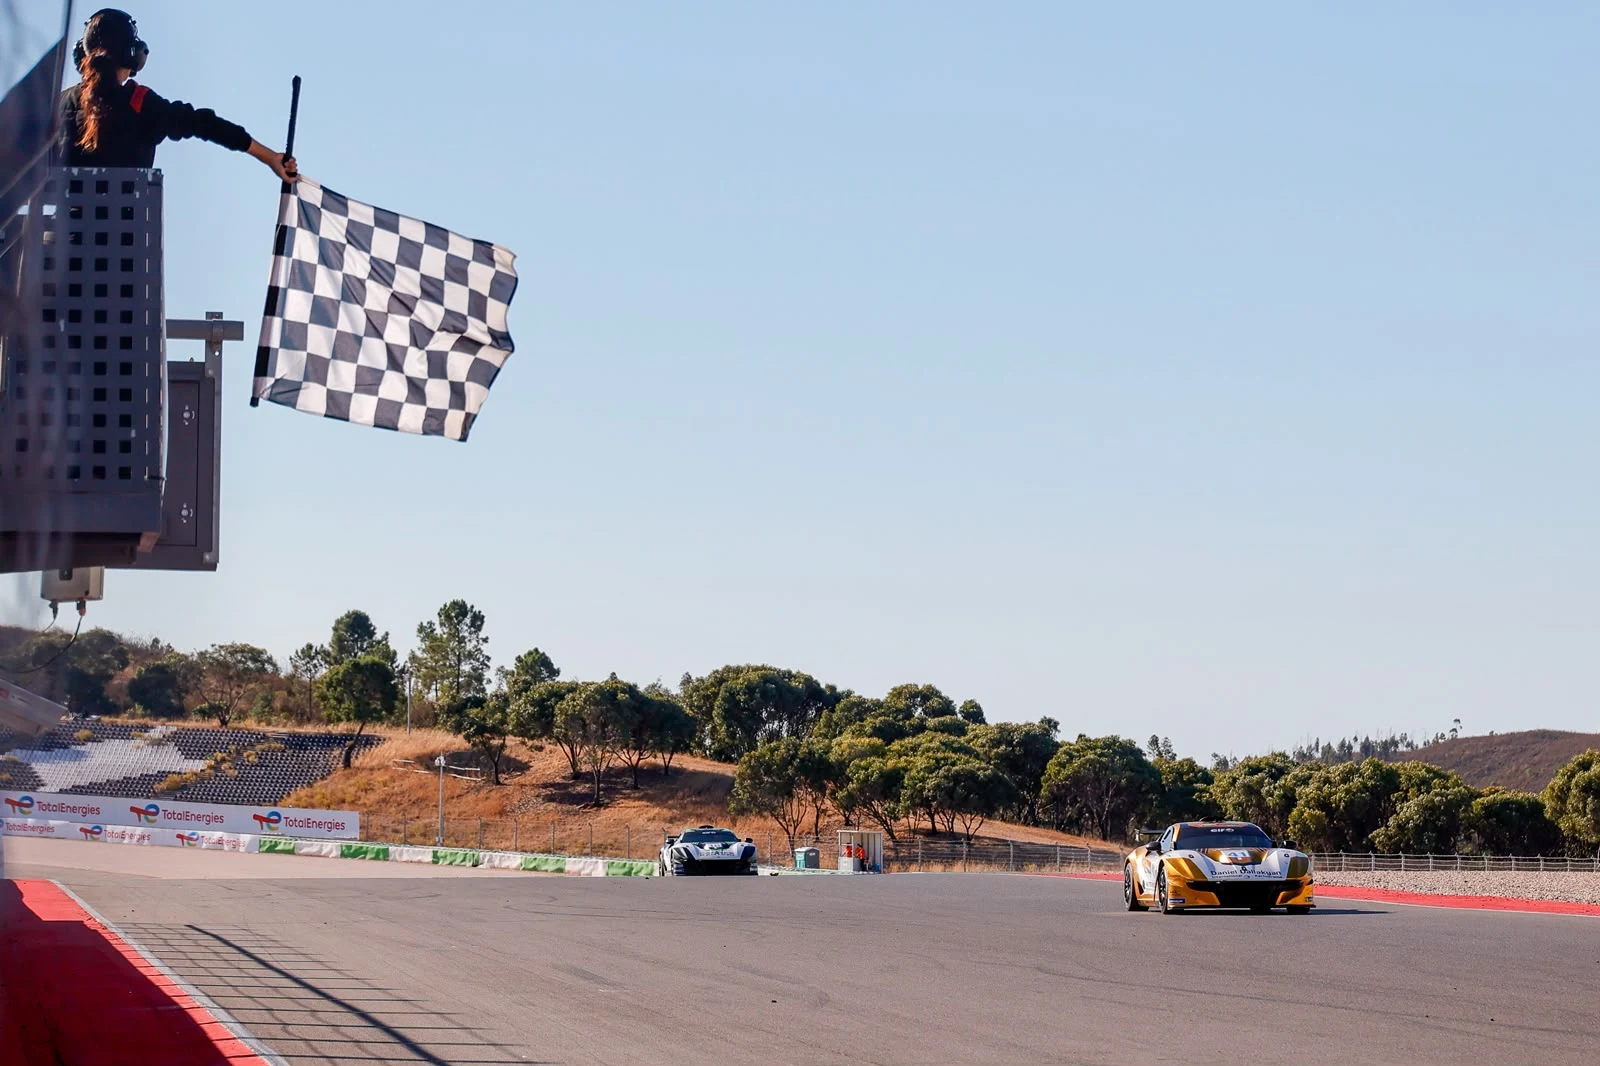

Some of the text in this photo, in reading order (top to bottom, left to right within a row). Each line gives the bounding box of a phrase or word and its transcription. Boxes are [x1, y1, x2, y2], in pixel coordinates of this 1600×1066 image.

[36, 801, 101, 817] TotalEnergies
[161, 809, 225, 825] TotalEnergies
[283, 816, 346, 832] TotalEnergies
[5, 822, 55, 834] TotalEnergies
[103, 829, 152, 842] TotalEnergies
[200, 835, 246, 848] TotalEnergies
